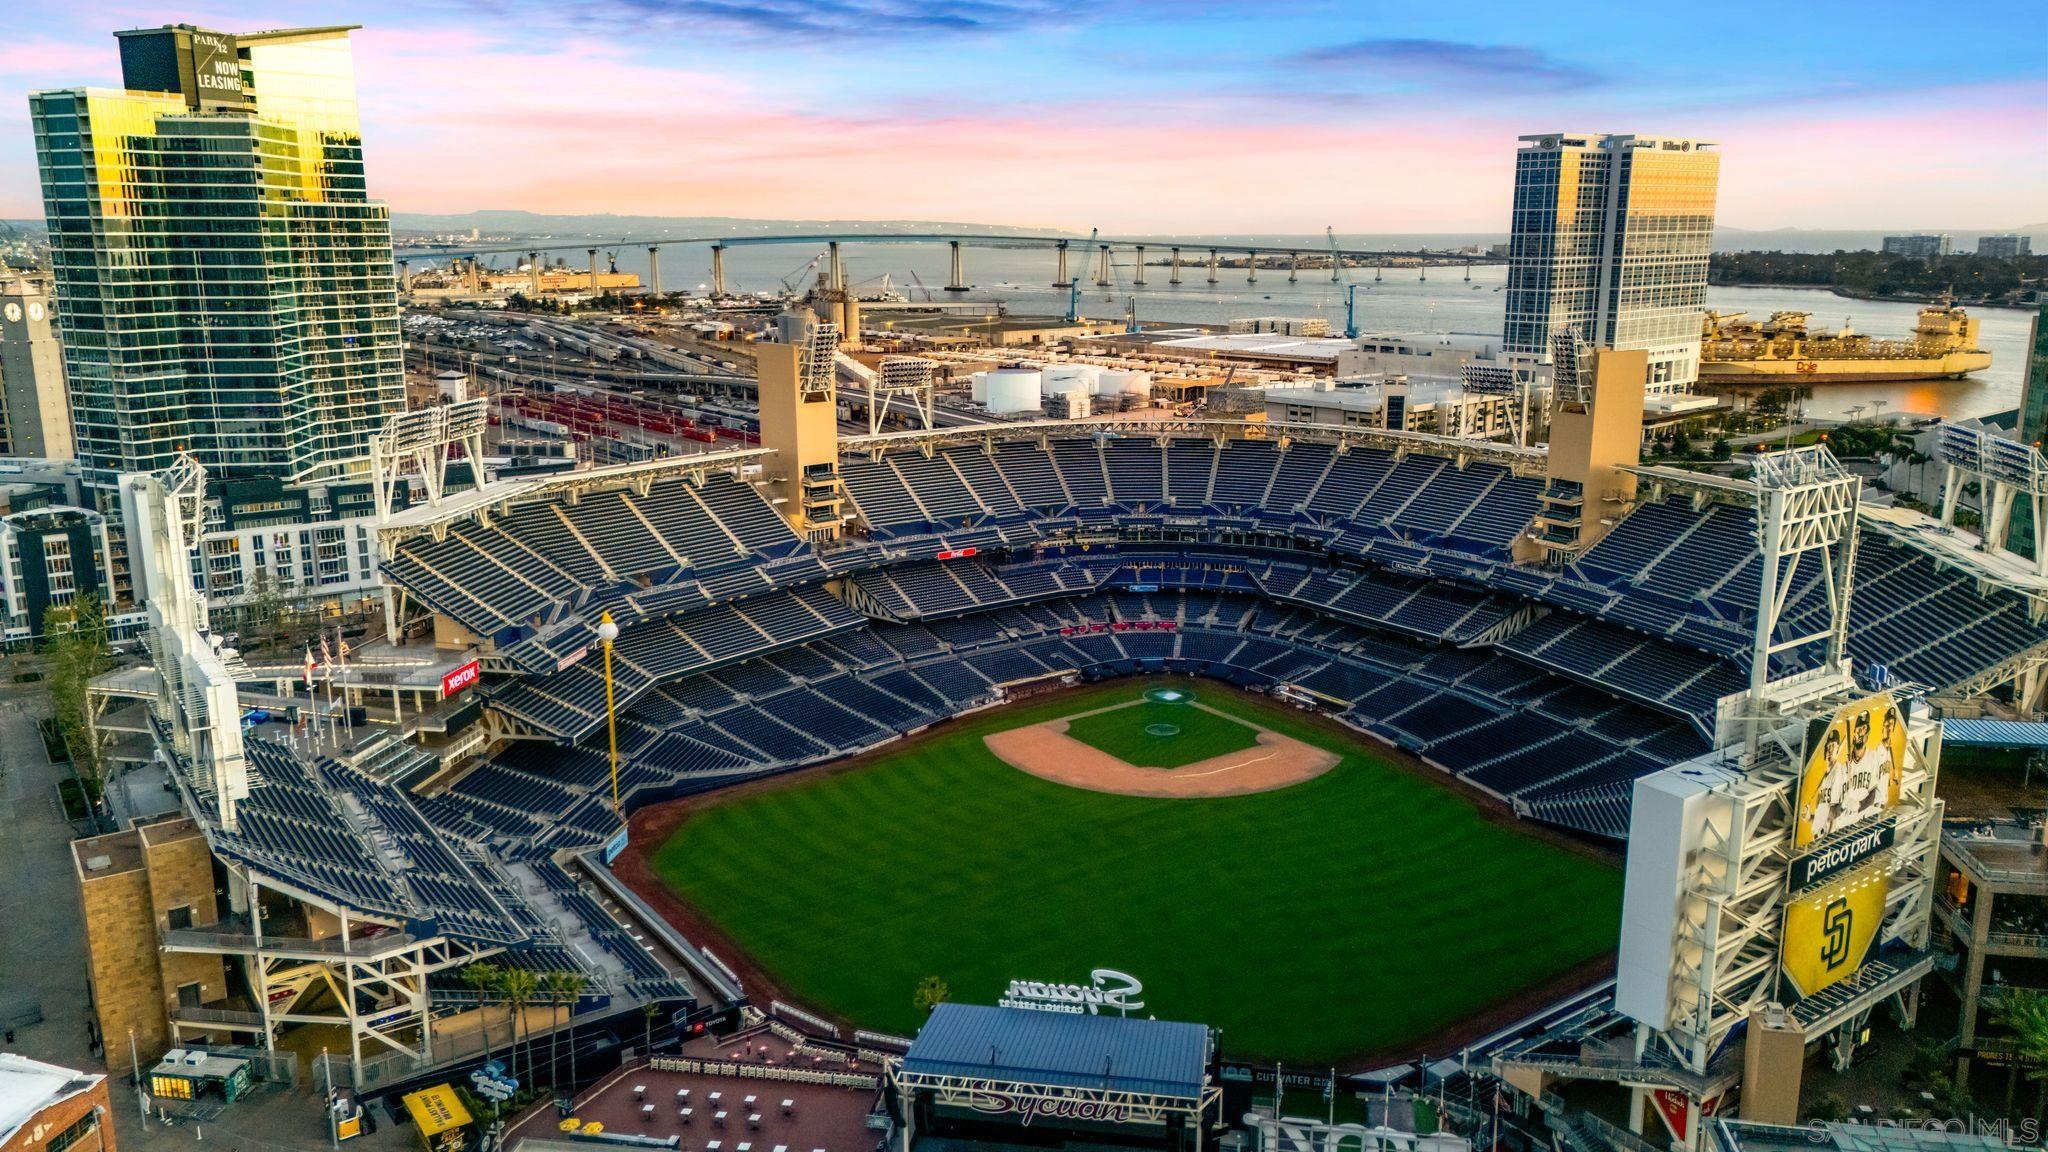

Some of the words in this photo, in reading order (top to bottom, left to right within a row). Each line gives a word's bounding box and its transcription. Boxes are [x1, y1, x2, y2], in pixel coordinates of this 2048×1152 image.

[194, 34, 221, 47] PARK
[218, 43, 228, 54] 12
[214, 60, 238, 76] NOW
[198, 74, 241, 91] LEASING
[1797, 361, 1818, 373] Dole
[448, 667, 476, 692] xerox
[1806, 845, 1851, 882] petco
[1849, 828, 1885, 862] park
[705, 1016, 727, 1027] TOYOTA
[971, 1080, 1129, 1127] Sycuan
